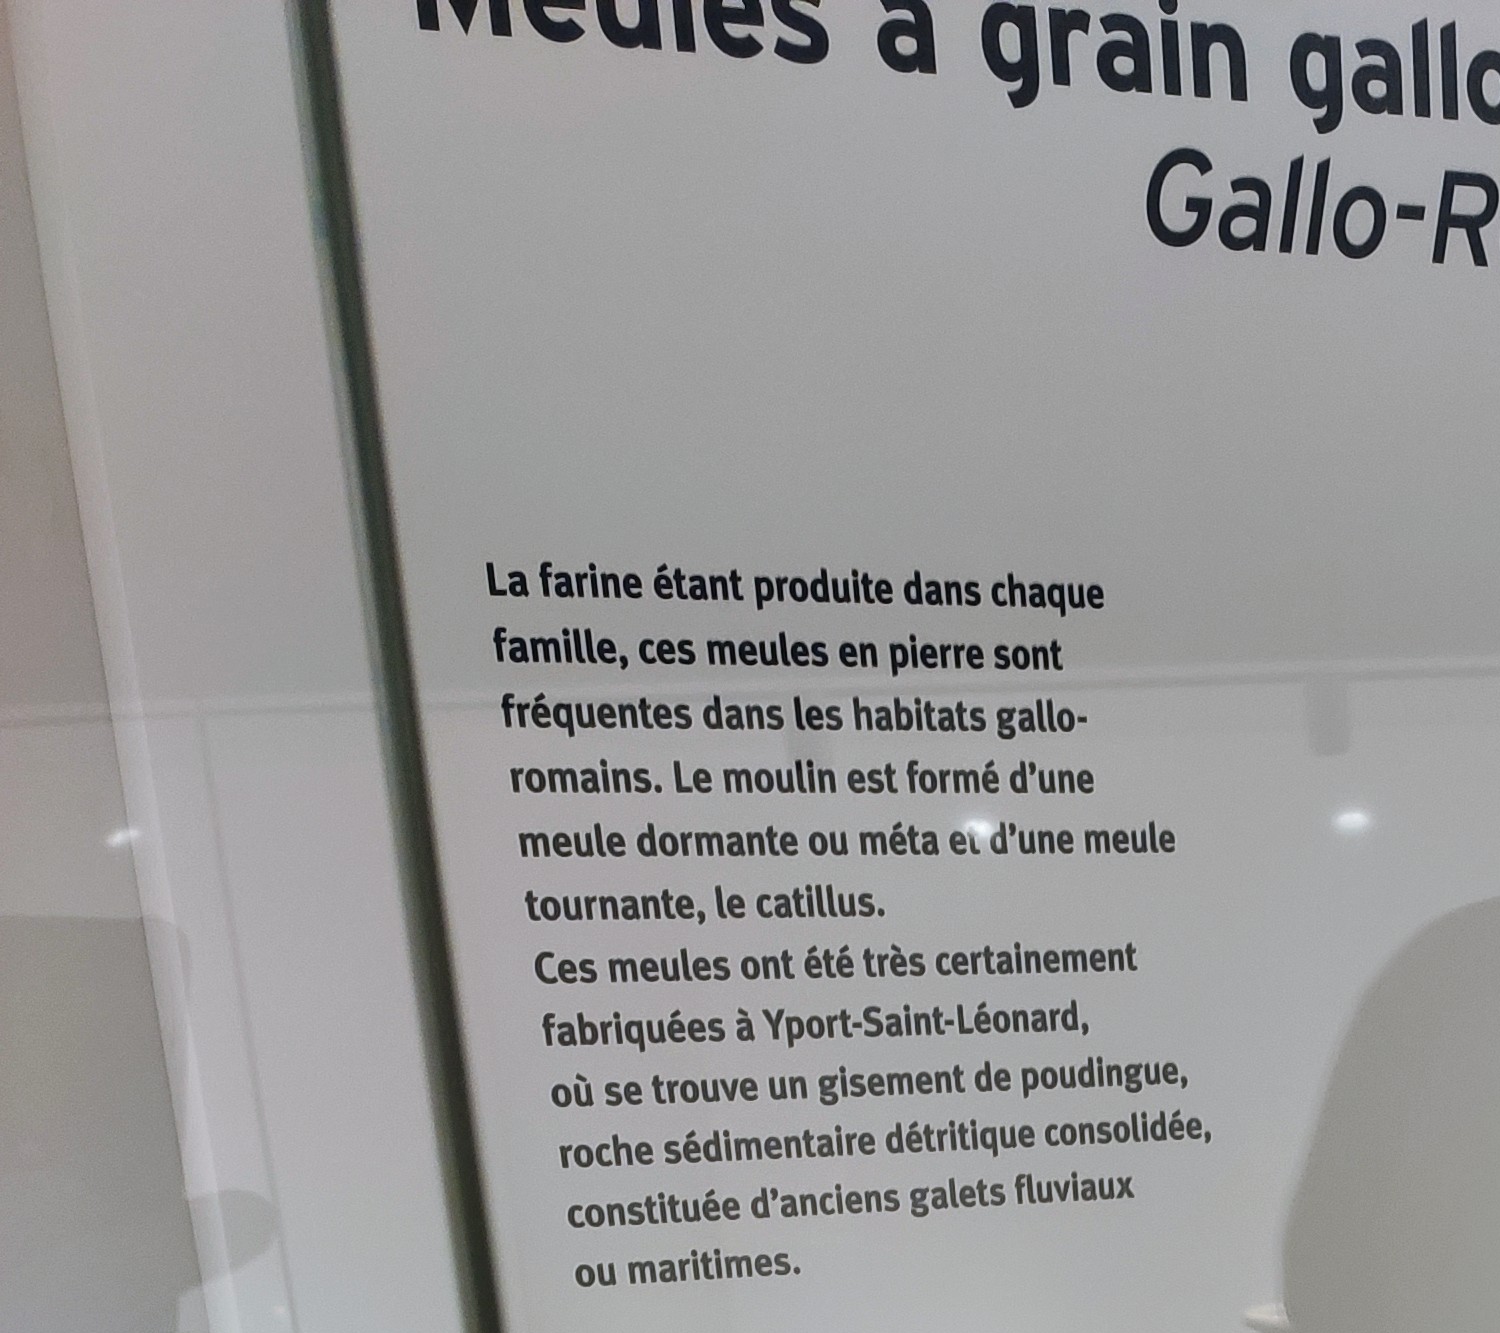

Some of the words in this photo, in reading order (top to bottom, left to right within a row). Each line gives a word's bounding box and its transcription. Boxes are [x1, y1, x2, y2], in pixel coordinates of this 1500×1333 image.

[980, 0, 1249, 109] grain
[485, 561, 530, 598] La
[538, 561, 643, 600] farine
[653, 563, 745, 602] étant
[753, 567, 894, 611] produite
[903, 569, 982, 607] dans
[990, 572, 1105, 618] chaque
[492, 626, 629, 671] famille,
[638, 638, 697, 666] ces
[706, 631, 829, 668] meules
[838, 641, 879, 668] en
[888, 633, 985, 678] pierre
[993, 639, 1064, 671] sont
[500, 692, 693, 738] fréquentes
[702, 694, 785, 731] dans
[793, 695, 844, 731] les
[852, 695, 987, 733] habitats
[996, 698, 1088, 741] gallo-
[509, 758, 663, 794] romains.
[673, 760, 713, 794] Le
[722, 759, 837, 794] moulin
[846, 762, 899, 795] est
[906, 759, 1000, 795] formé
[524, 888, 706, 926] tournante,
[714, 885, 746, 920] le
[755, 883, 886, 919] catillus.
[534, 951, 598, 985] Ces
[607, 947, 731, 983] meules
[740, 949, 796, 981] ont
[803, 944, 855, 979] été
[862, 943, 927, 978] très
[935, 941, 1138, 977] certainement
[541, 1008, 726, 1053] fabriquées
[735, 1007, 756, 1042] à
[761, 999, 1090, 1049] Yport-Saint-Léonard,
[559, 1133, 654, 1169] roche
[663, 1124, 876, 1165] sédimentaire
[885, 1118, 1036, 1158] détritique
[1044, 1108, 1212, 1147] consolidée,
[567, 1188, 741, 1229] constituée
[909, 1177, 1007, 1218] galets
[1014, 1170, 1135, 1205] fluviaux
[574, 1262, 617, 1288] ou
[627, 1247, 801, 1285] maritimes.
